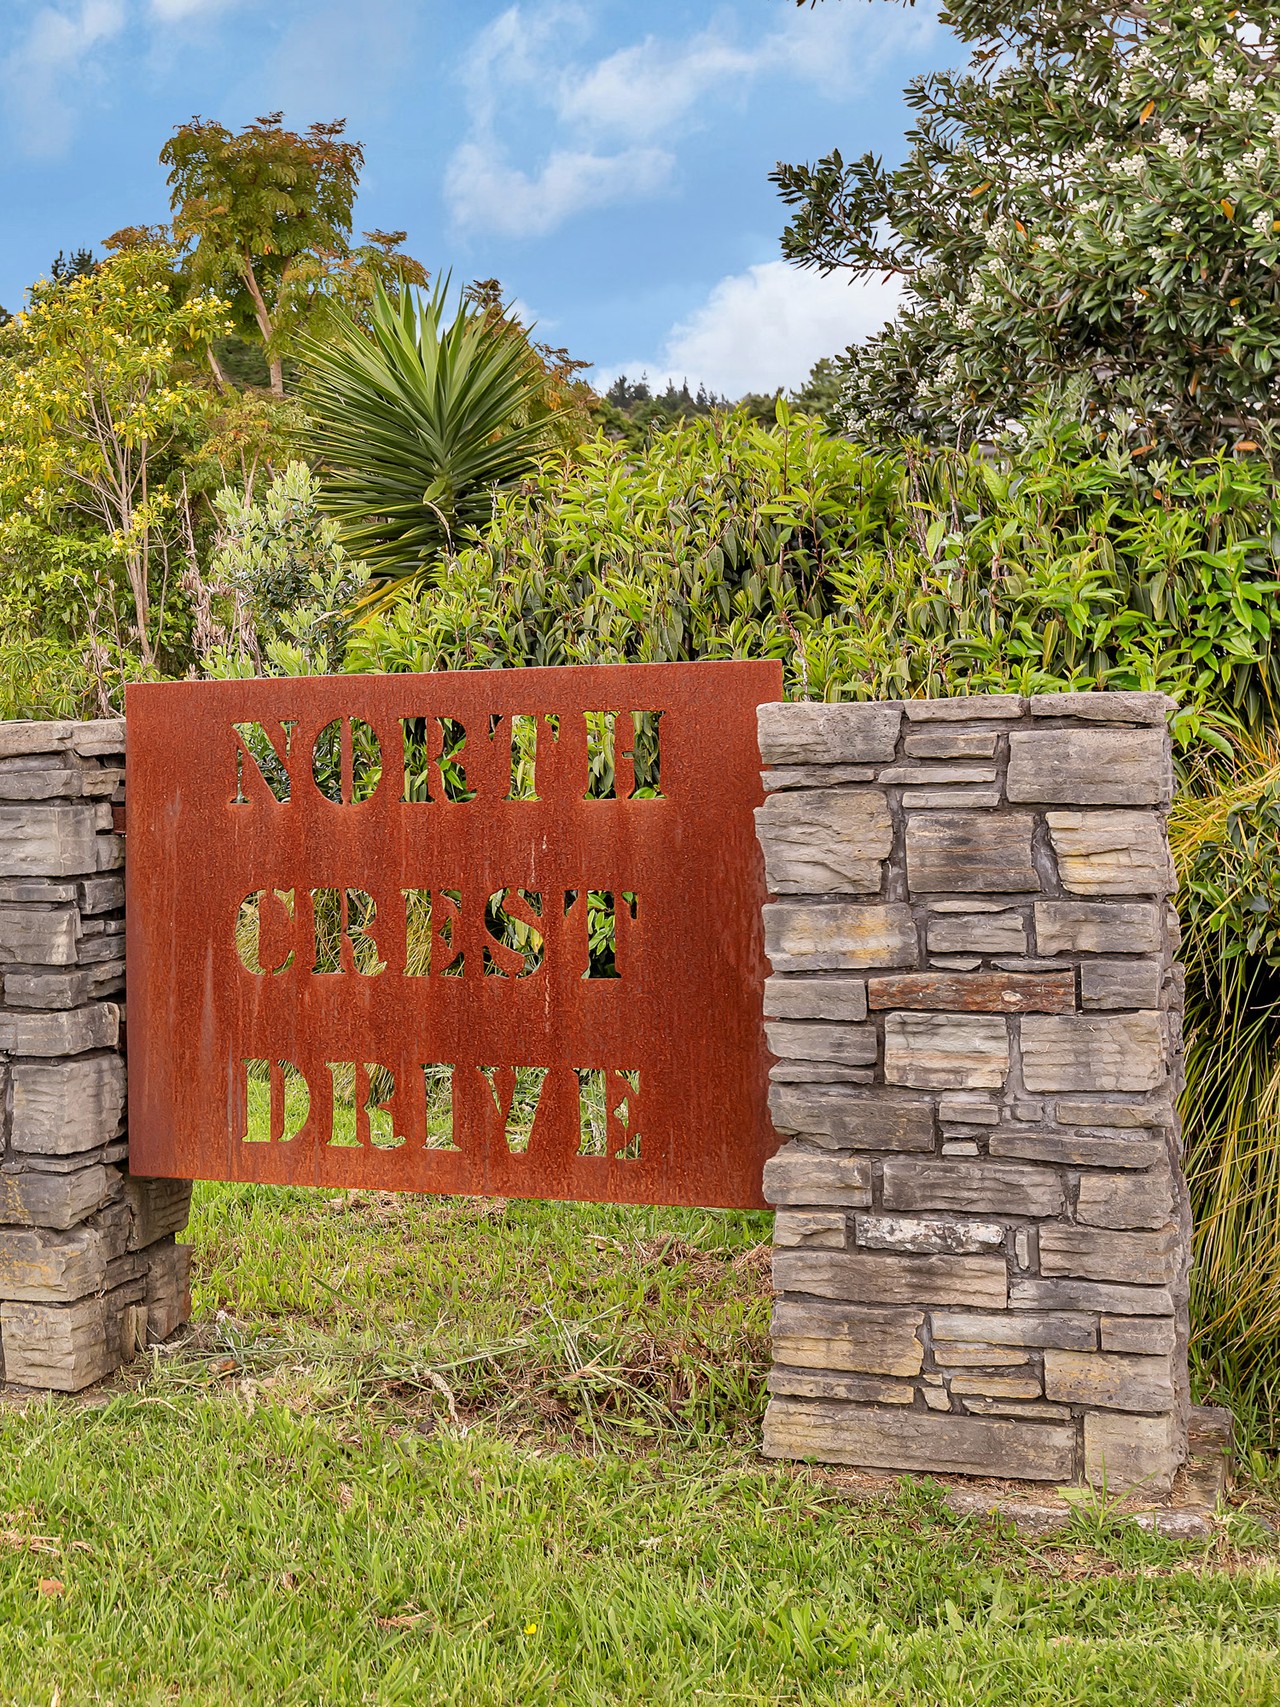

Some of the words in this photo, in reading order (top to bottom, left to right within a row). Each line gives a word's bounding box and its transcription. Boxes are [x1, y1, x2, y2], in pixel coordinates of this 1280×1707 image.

[229, 709, 667, 805] NORTH
[234, 887, 639, 980] CREST
[240, 1057, 642, 1160] DRIVE
